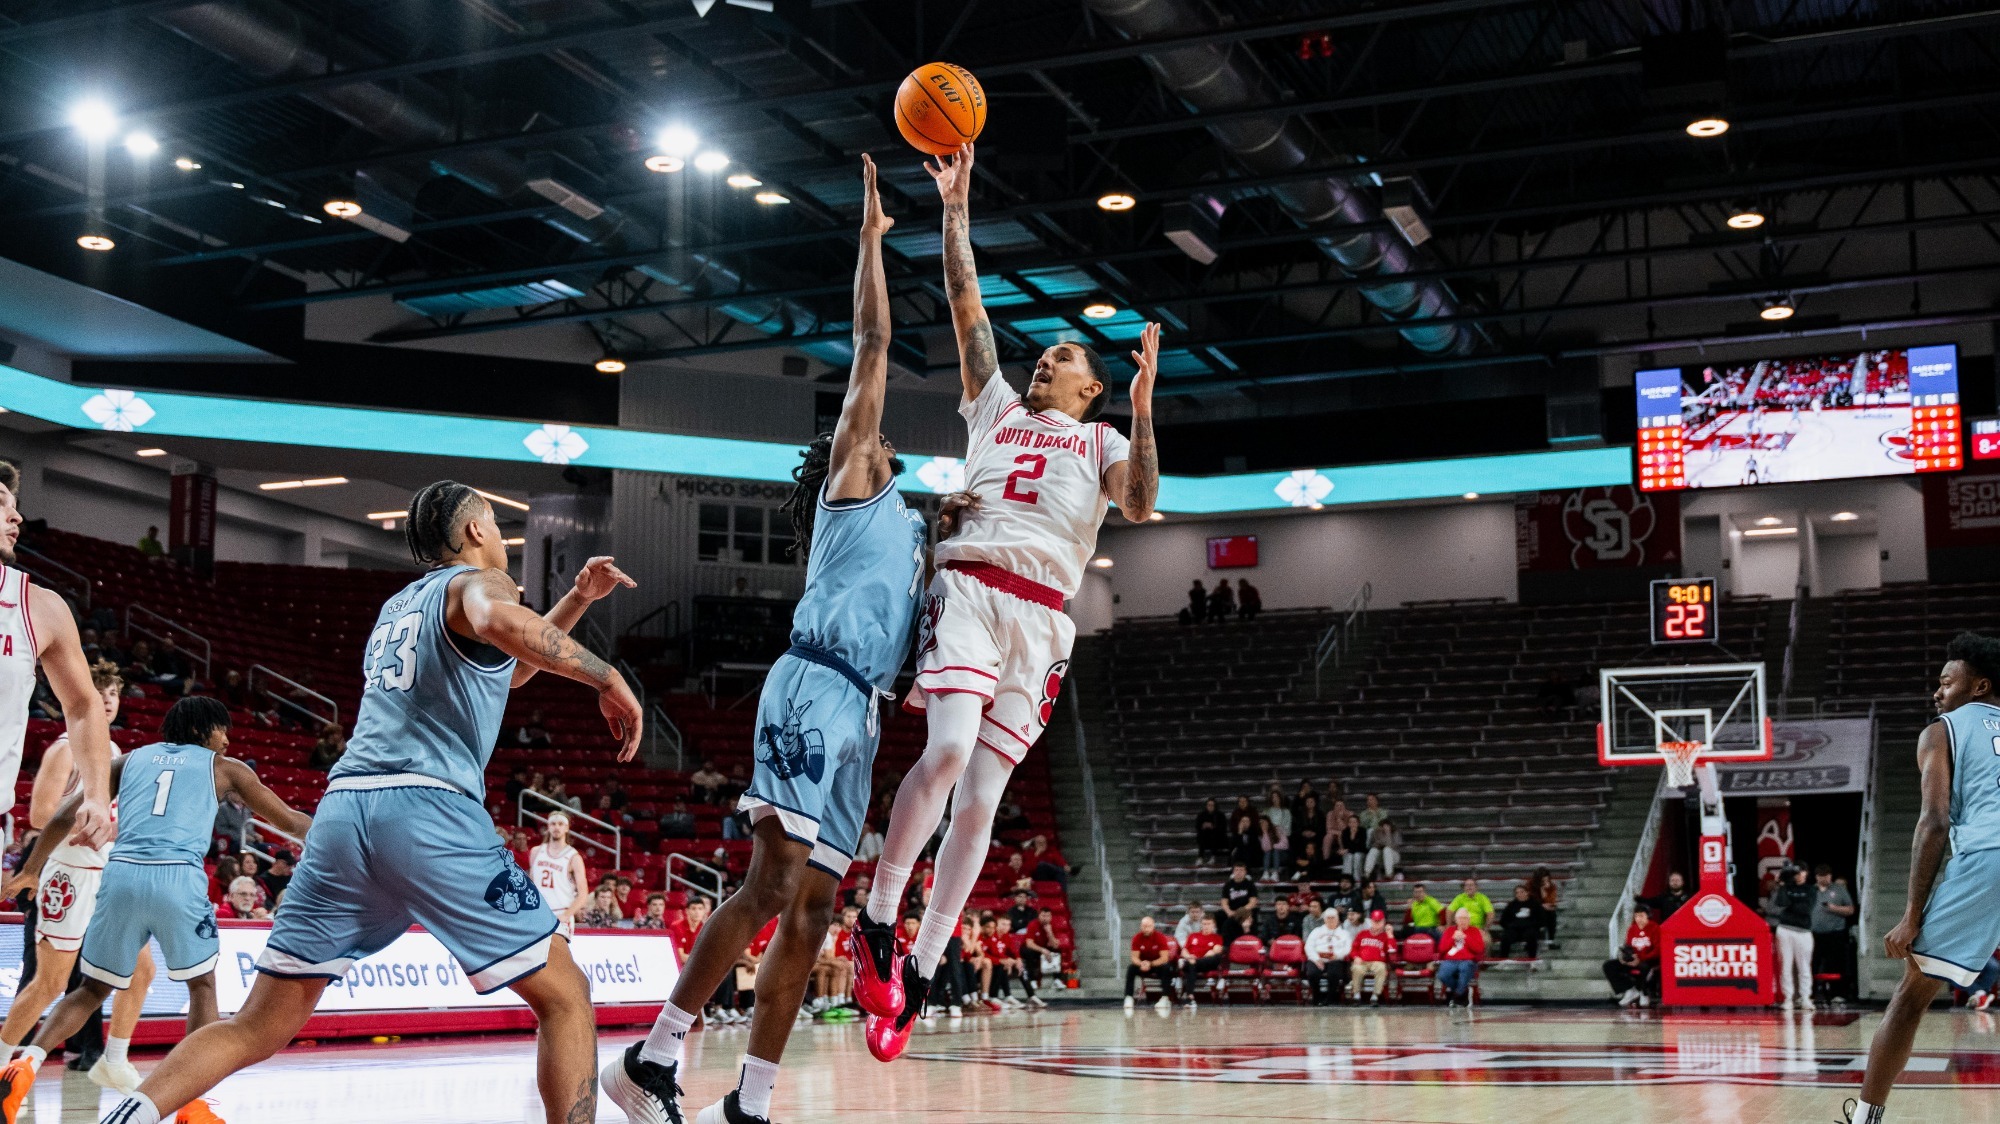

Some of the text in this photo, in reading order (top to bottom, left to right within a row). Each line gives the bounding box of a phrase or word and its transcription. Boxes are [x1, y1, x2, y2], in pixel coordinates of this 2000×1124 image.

[1916, 421, 1924, 432] 1
[1978, 438, 2000, 454] 8-
[1933, 458, 1941, 468] 1
[1002, 453, 1048, 505] 2
[1668, 585, 1711, 604] 9:01
[1665, 604, 1705, 637] 22
[0, 634, 13, 657] A
[363, 610, 424, 693] 23
[151, 754, 188, 766] PETTY
[151, 769, 175, 817] 1
[541, 869, 555, 889] 21
[1673, 944, 1758, 963] SOUTH
[435, 954, 458, 986] of
[1674, 961, 1758, 978] DAKOTA
